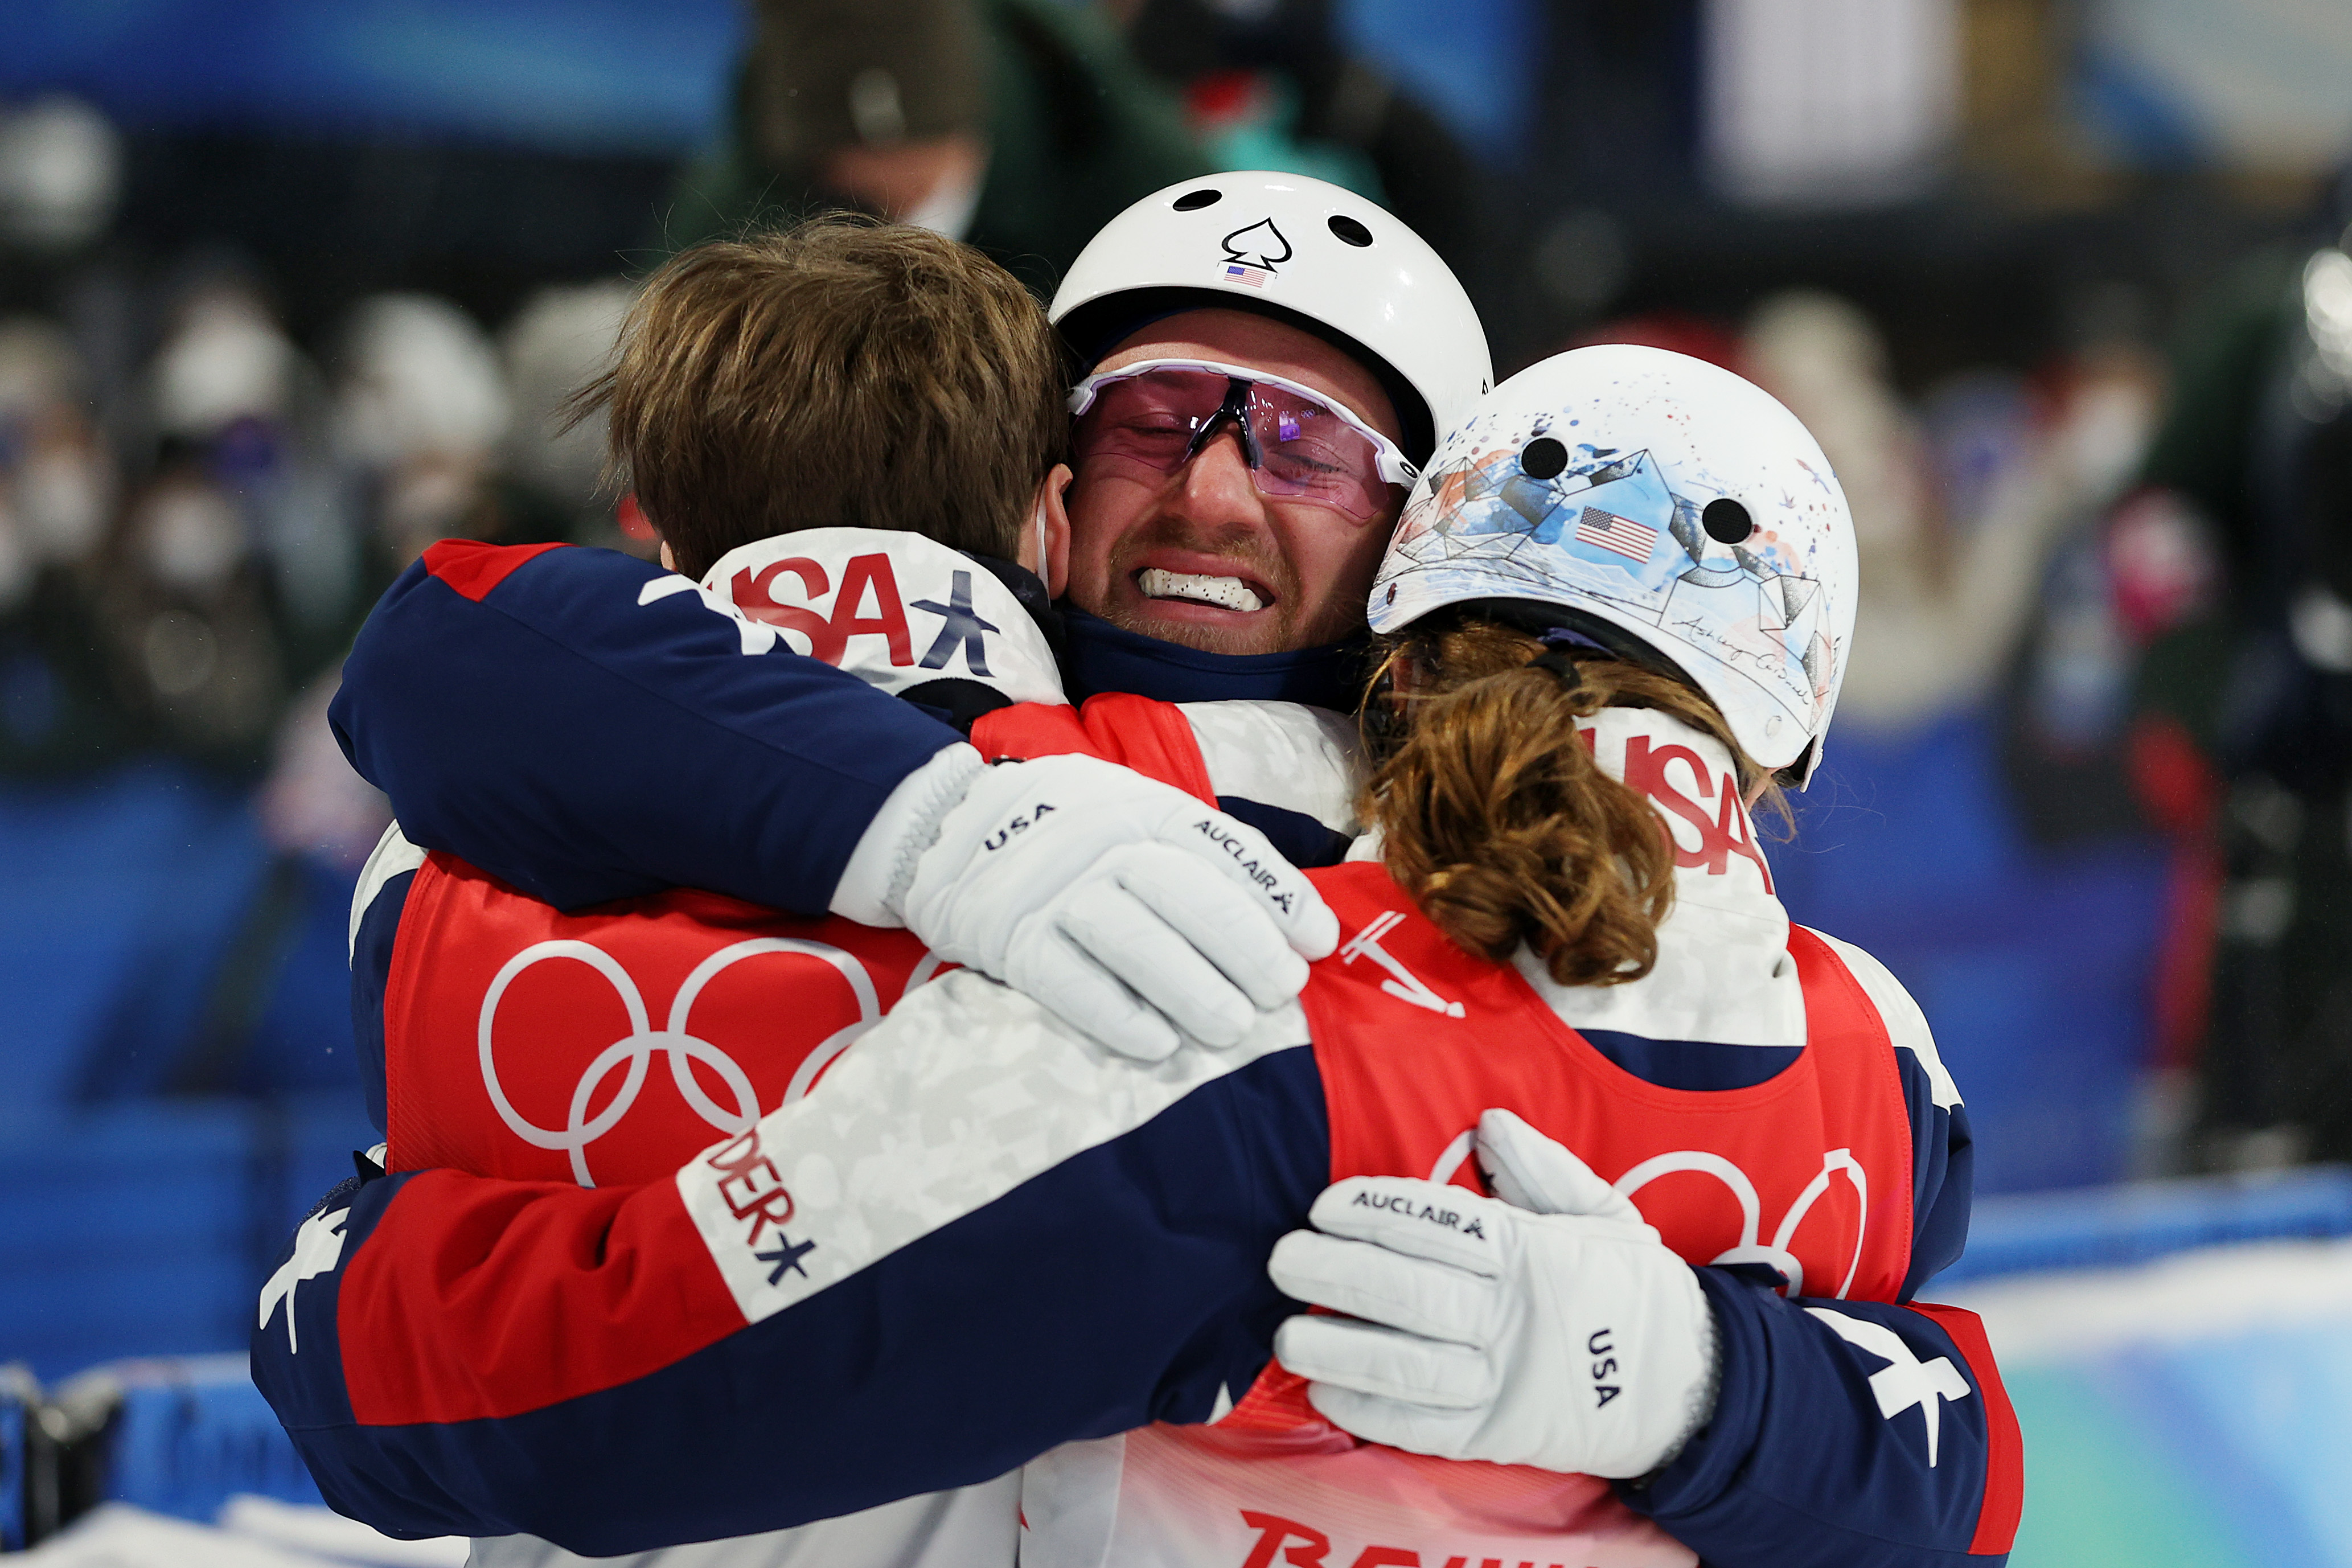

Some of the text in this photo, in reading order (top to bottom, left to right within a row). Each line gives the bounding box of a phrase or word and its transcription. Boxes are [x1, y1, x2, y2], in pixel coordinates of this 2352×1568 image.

[707, 552, 915, 667] SA
[984, 803, 1056, 851] USA
[1193, 820, 1276, 891] AUCLAIR
[1352, 1192, 1460, 1229] AUCLAIR
[1588, 1328, 1622, 1409] USA
